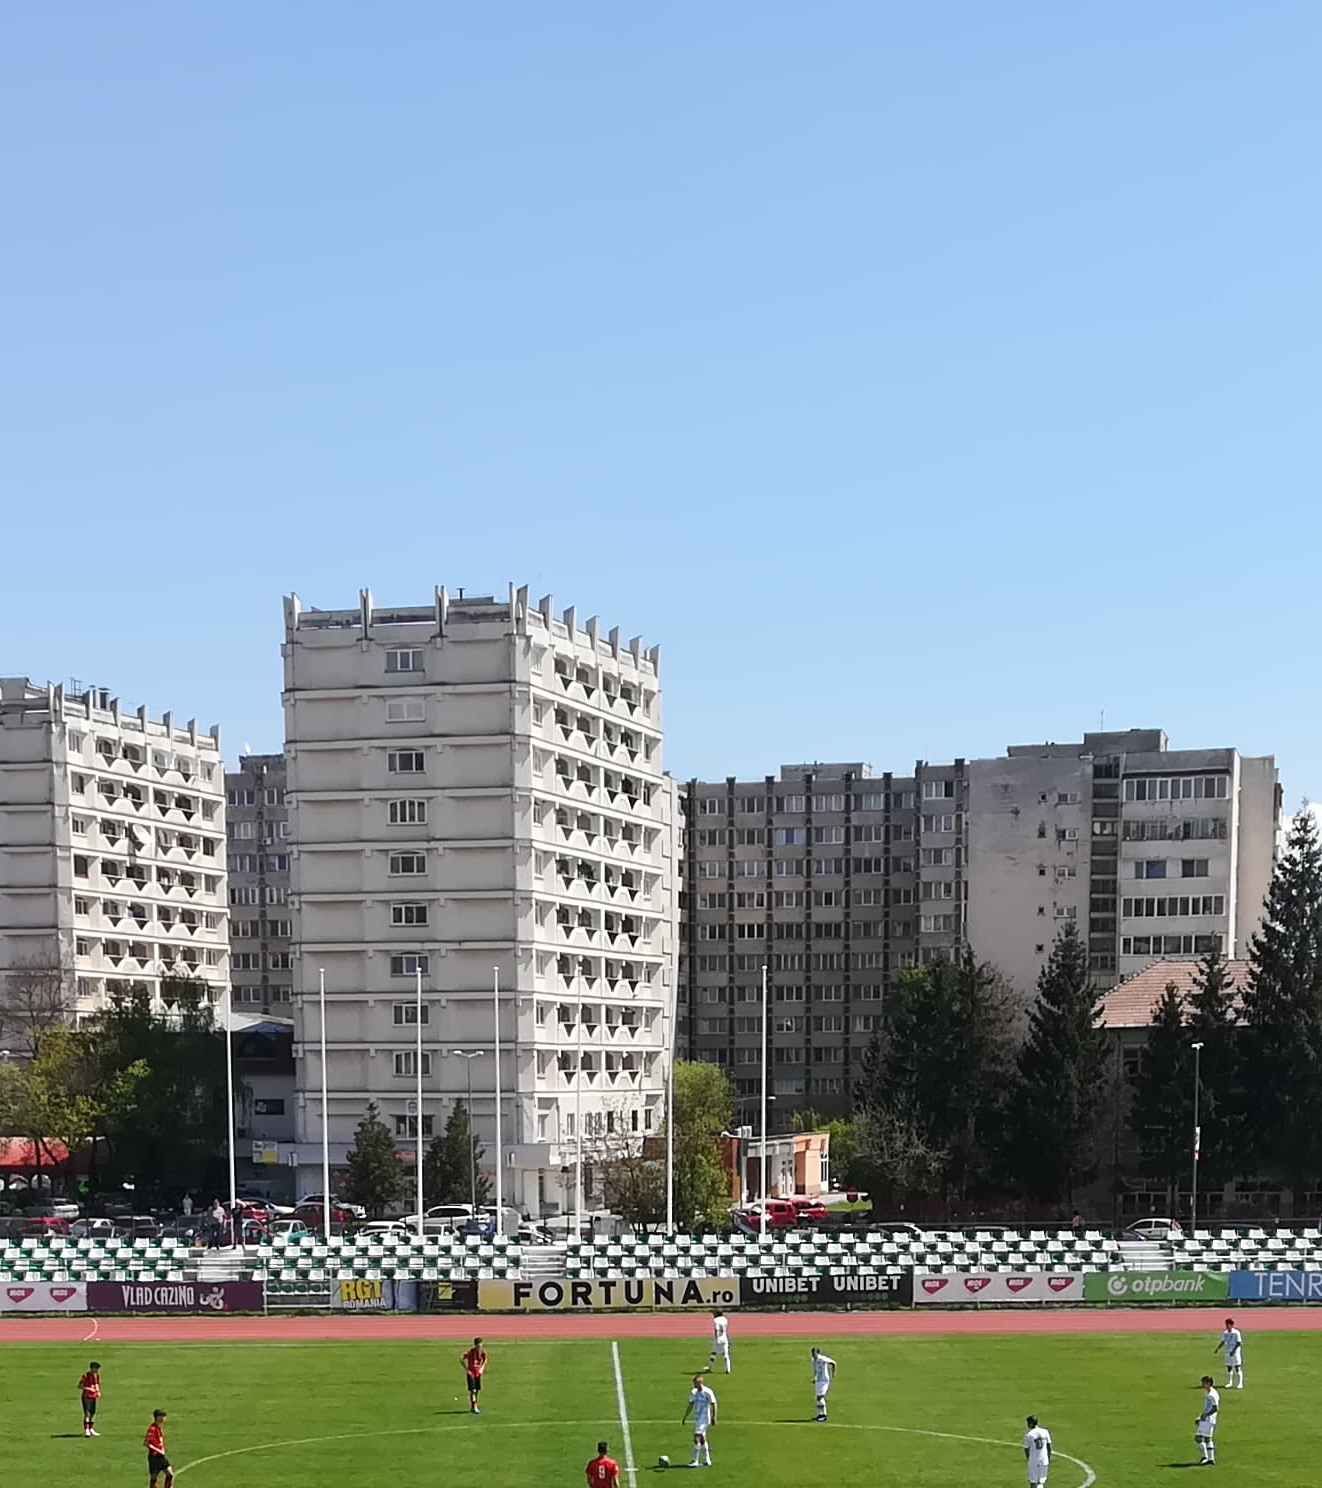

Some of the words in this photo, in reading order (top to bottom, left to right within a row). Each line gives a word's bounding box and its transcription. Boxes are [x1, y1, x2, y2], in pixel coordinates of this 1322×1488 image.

[752, 1277, 820, 1293] UNIBET
[833, 1275, 901, 1291] UNIBET
[1132, 1274, 1205, 1294] otpbank
[121, 1285, 153, 1307] VLAD
[153, 1286, 194, 1307] CAZINO
[343, 1298, 387, 1308] ROMANIA
